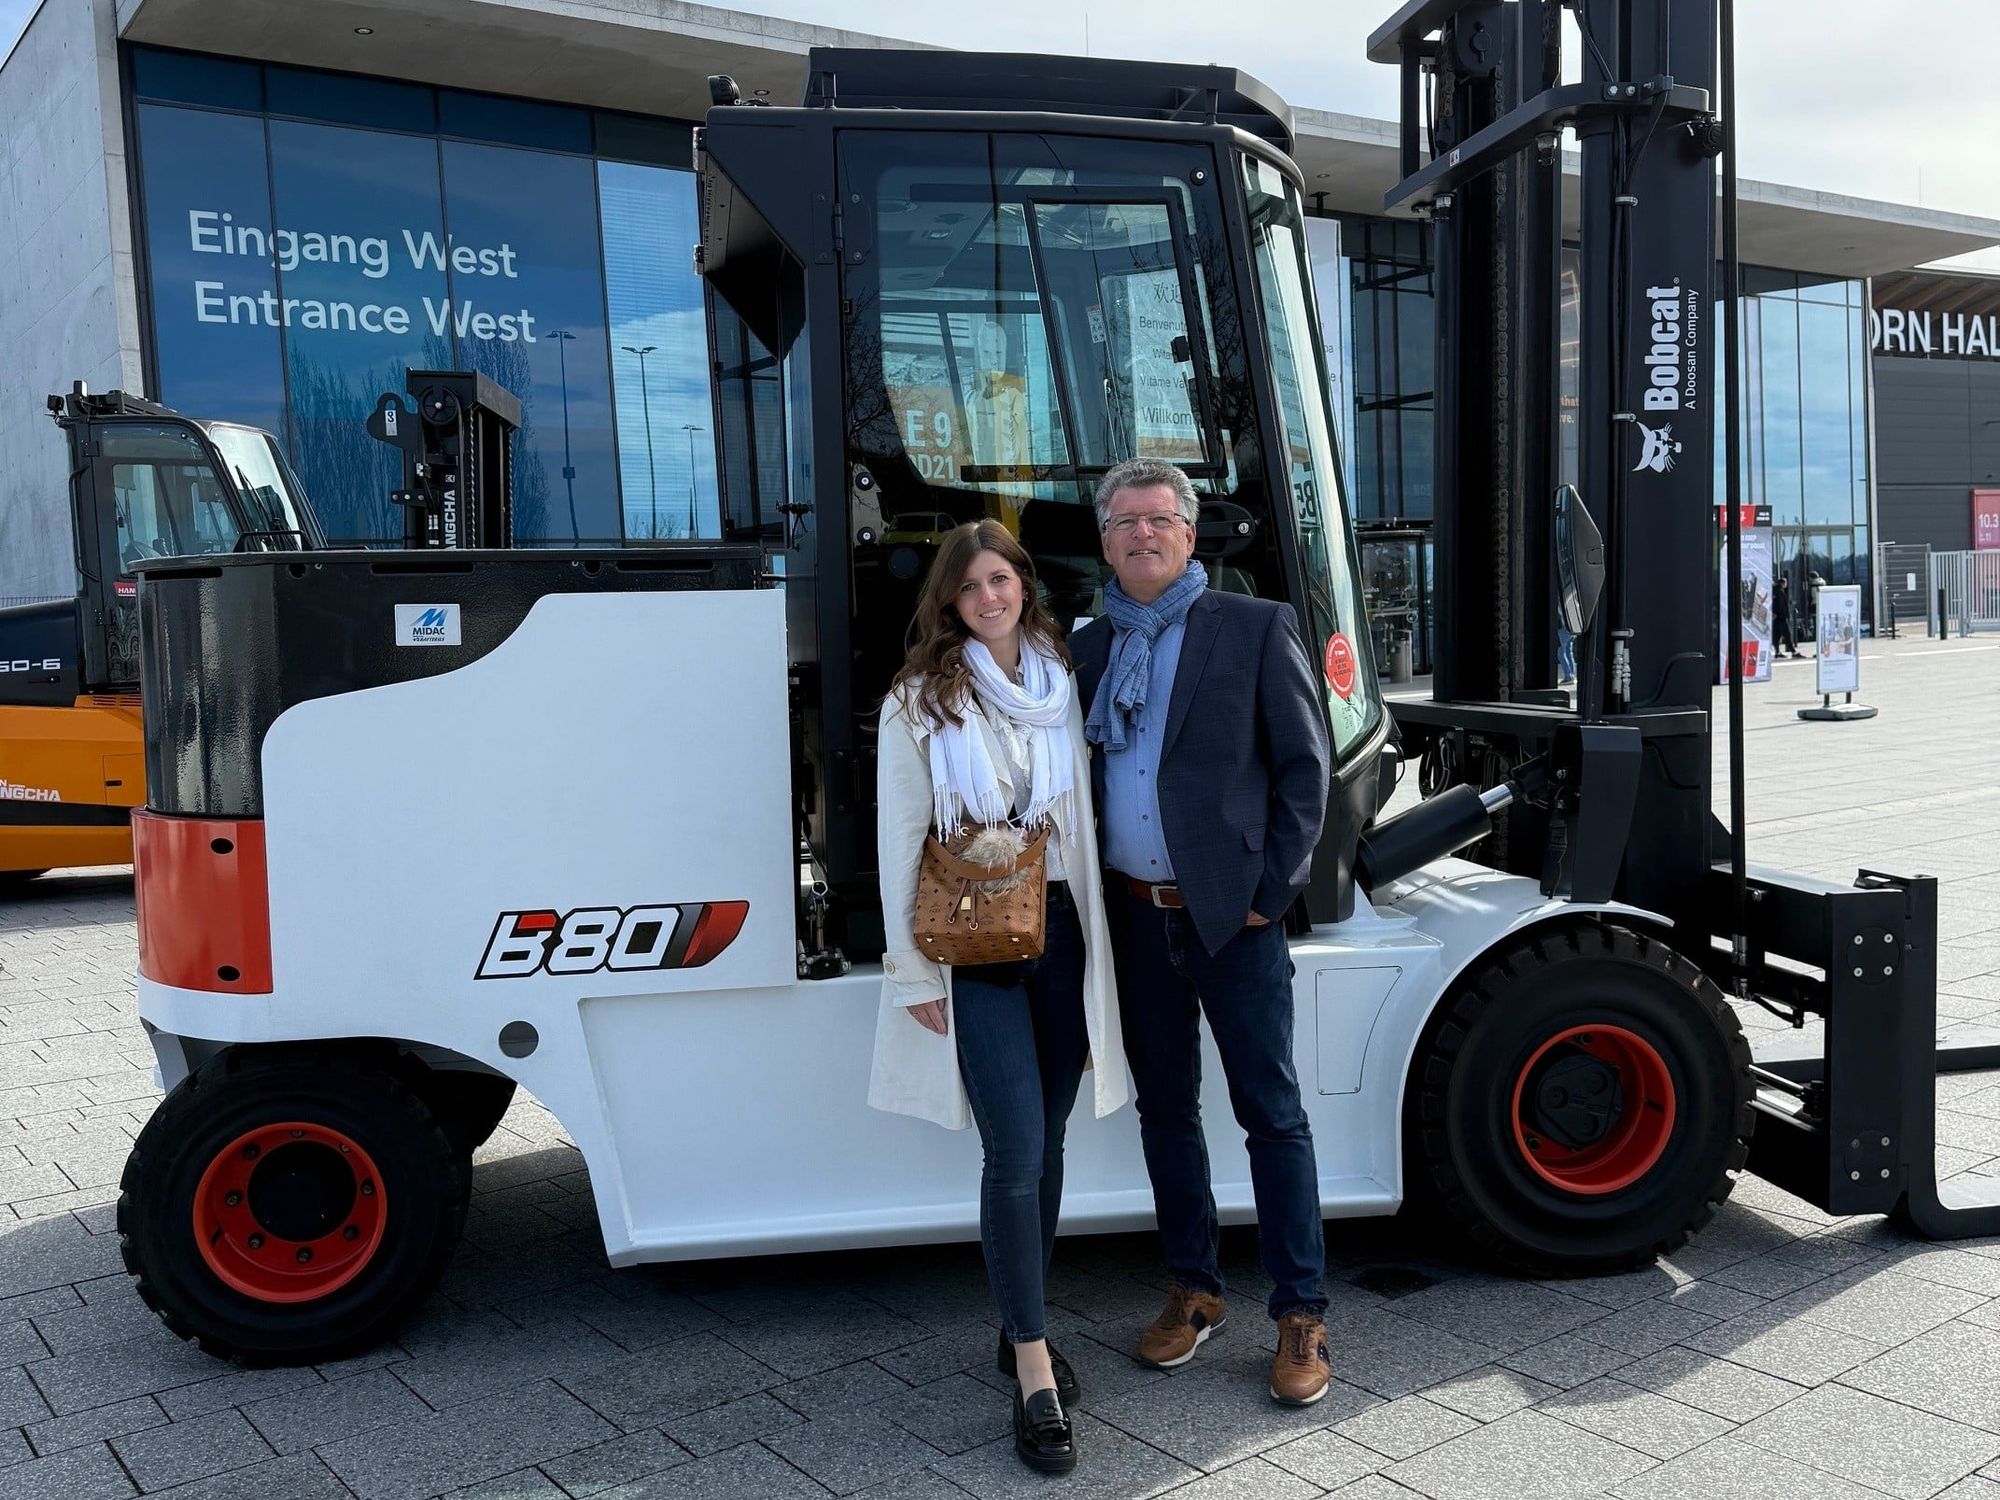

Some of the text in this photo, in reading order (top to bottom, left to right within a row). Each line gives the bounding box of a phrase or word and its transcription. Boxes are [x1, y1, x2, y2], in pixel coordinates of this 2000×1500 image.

[189, 210, 518, 279] Eingang West
[195, 281, 537, 343] Entrance West
[1643, 286, 1680, 410] Bobcat
[1685, 289, 1699, 410] A Doosan Company
[1978, 513, 1999, 528] 10.3
[412, 627, 446, 636] MIDAC
[474, 902, 684, 980] B80
